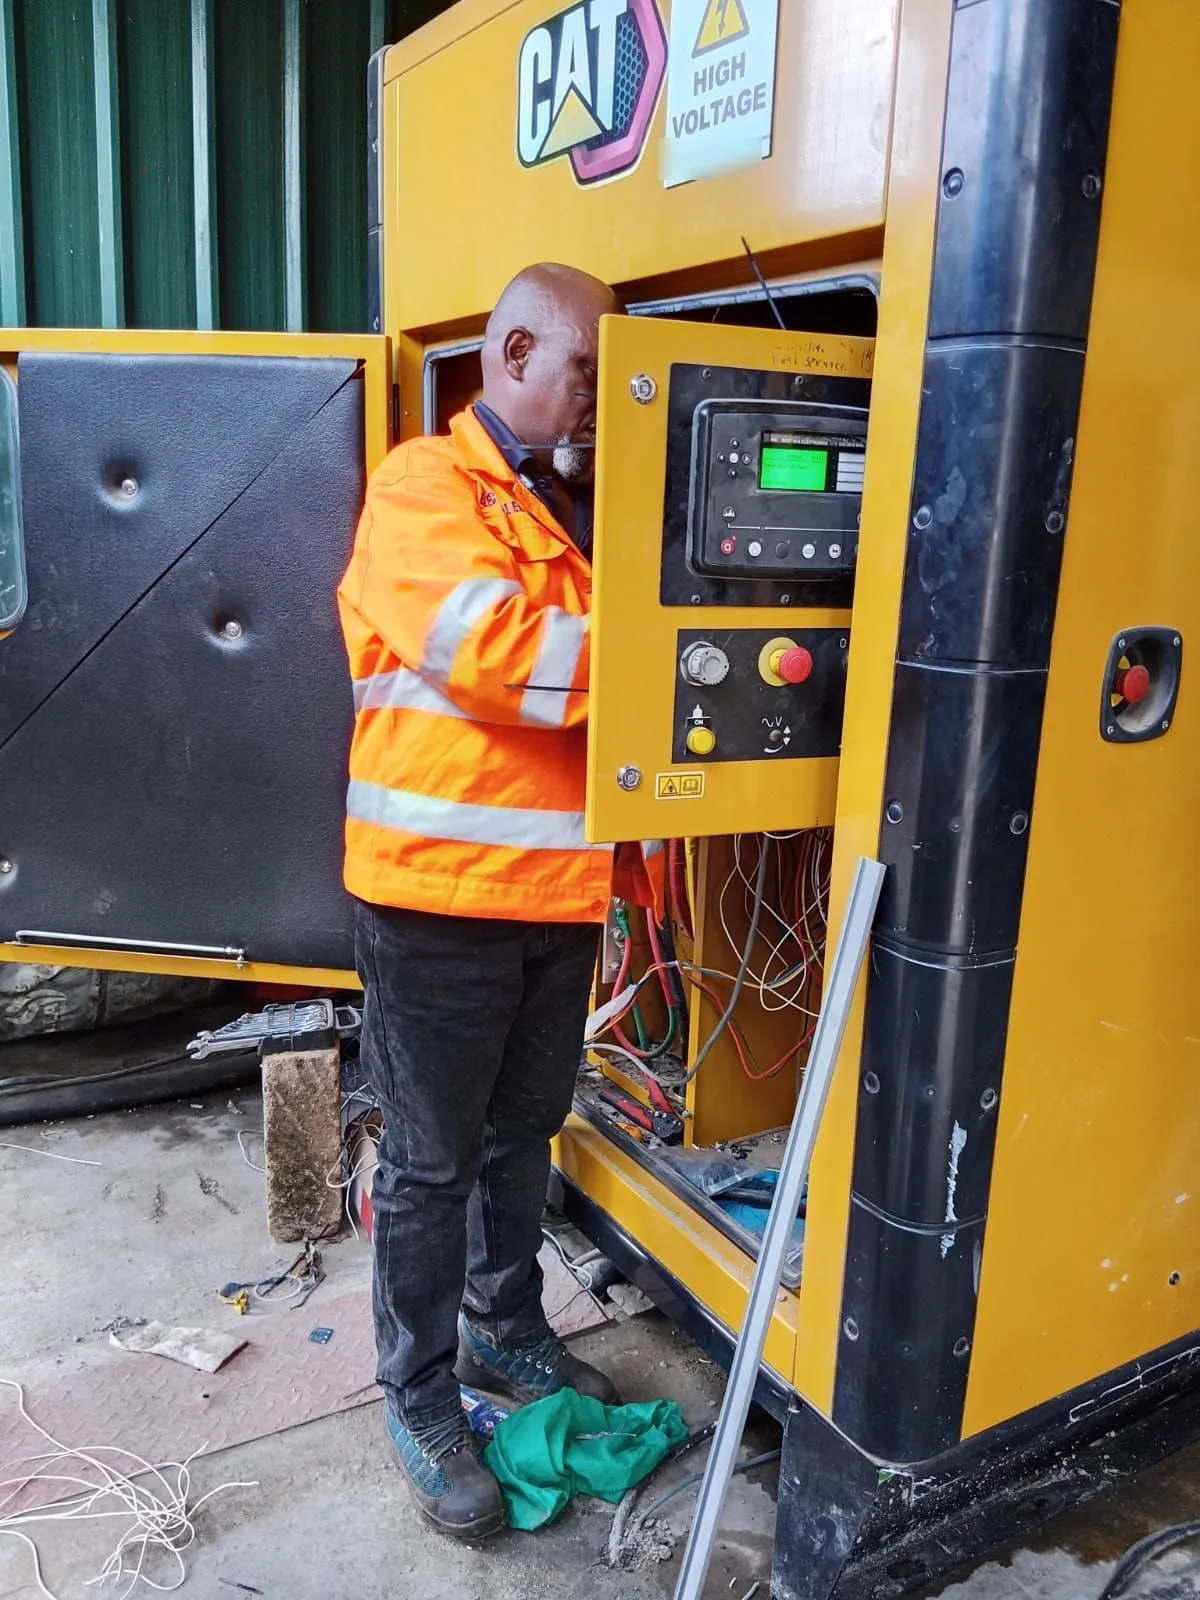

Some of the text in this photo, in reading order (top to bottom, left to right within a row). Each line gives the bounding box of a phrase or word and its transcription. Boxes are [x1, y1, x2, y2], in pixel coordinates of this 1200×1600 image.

[519, 0, 628, 163] CAT
[693, 52, 746, 97] HIGH
[672, 82, 767, 139] VOLTAGE
